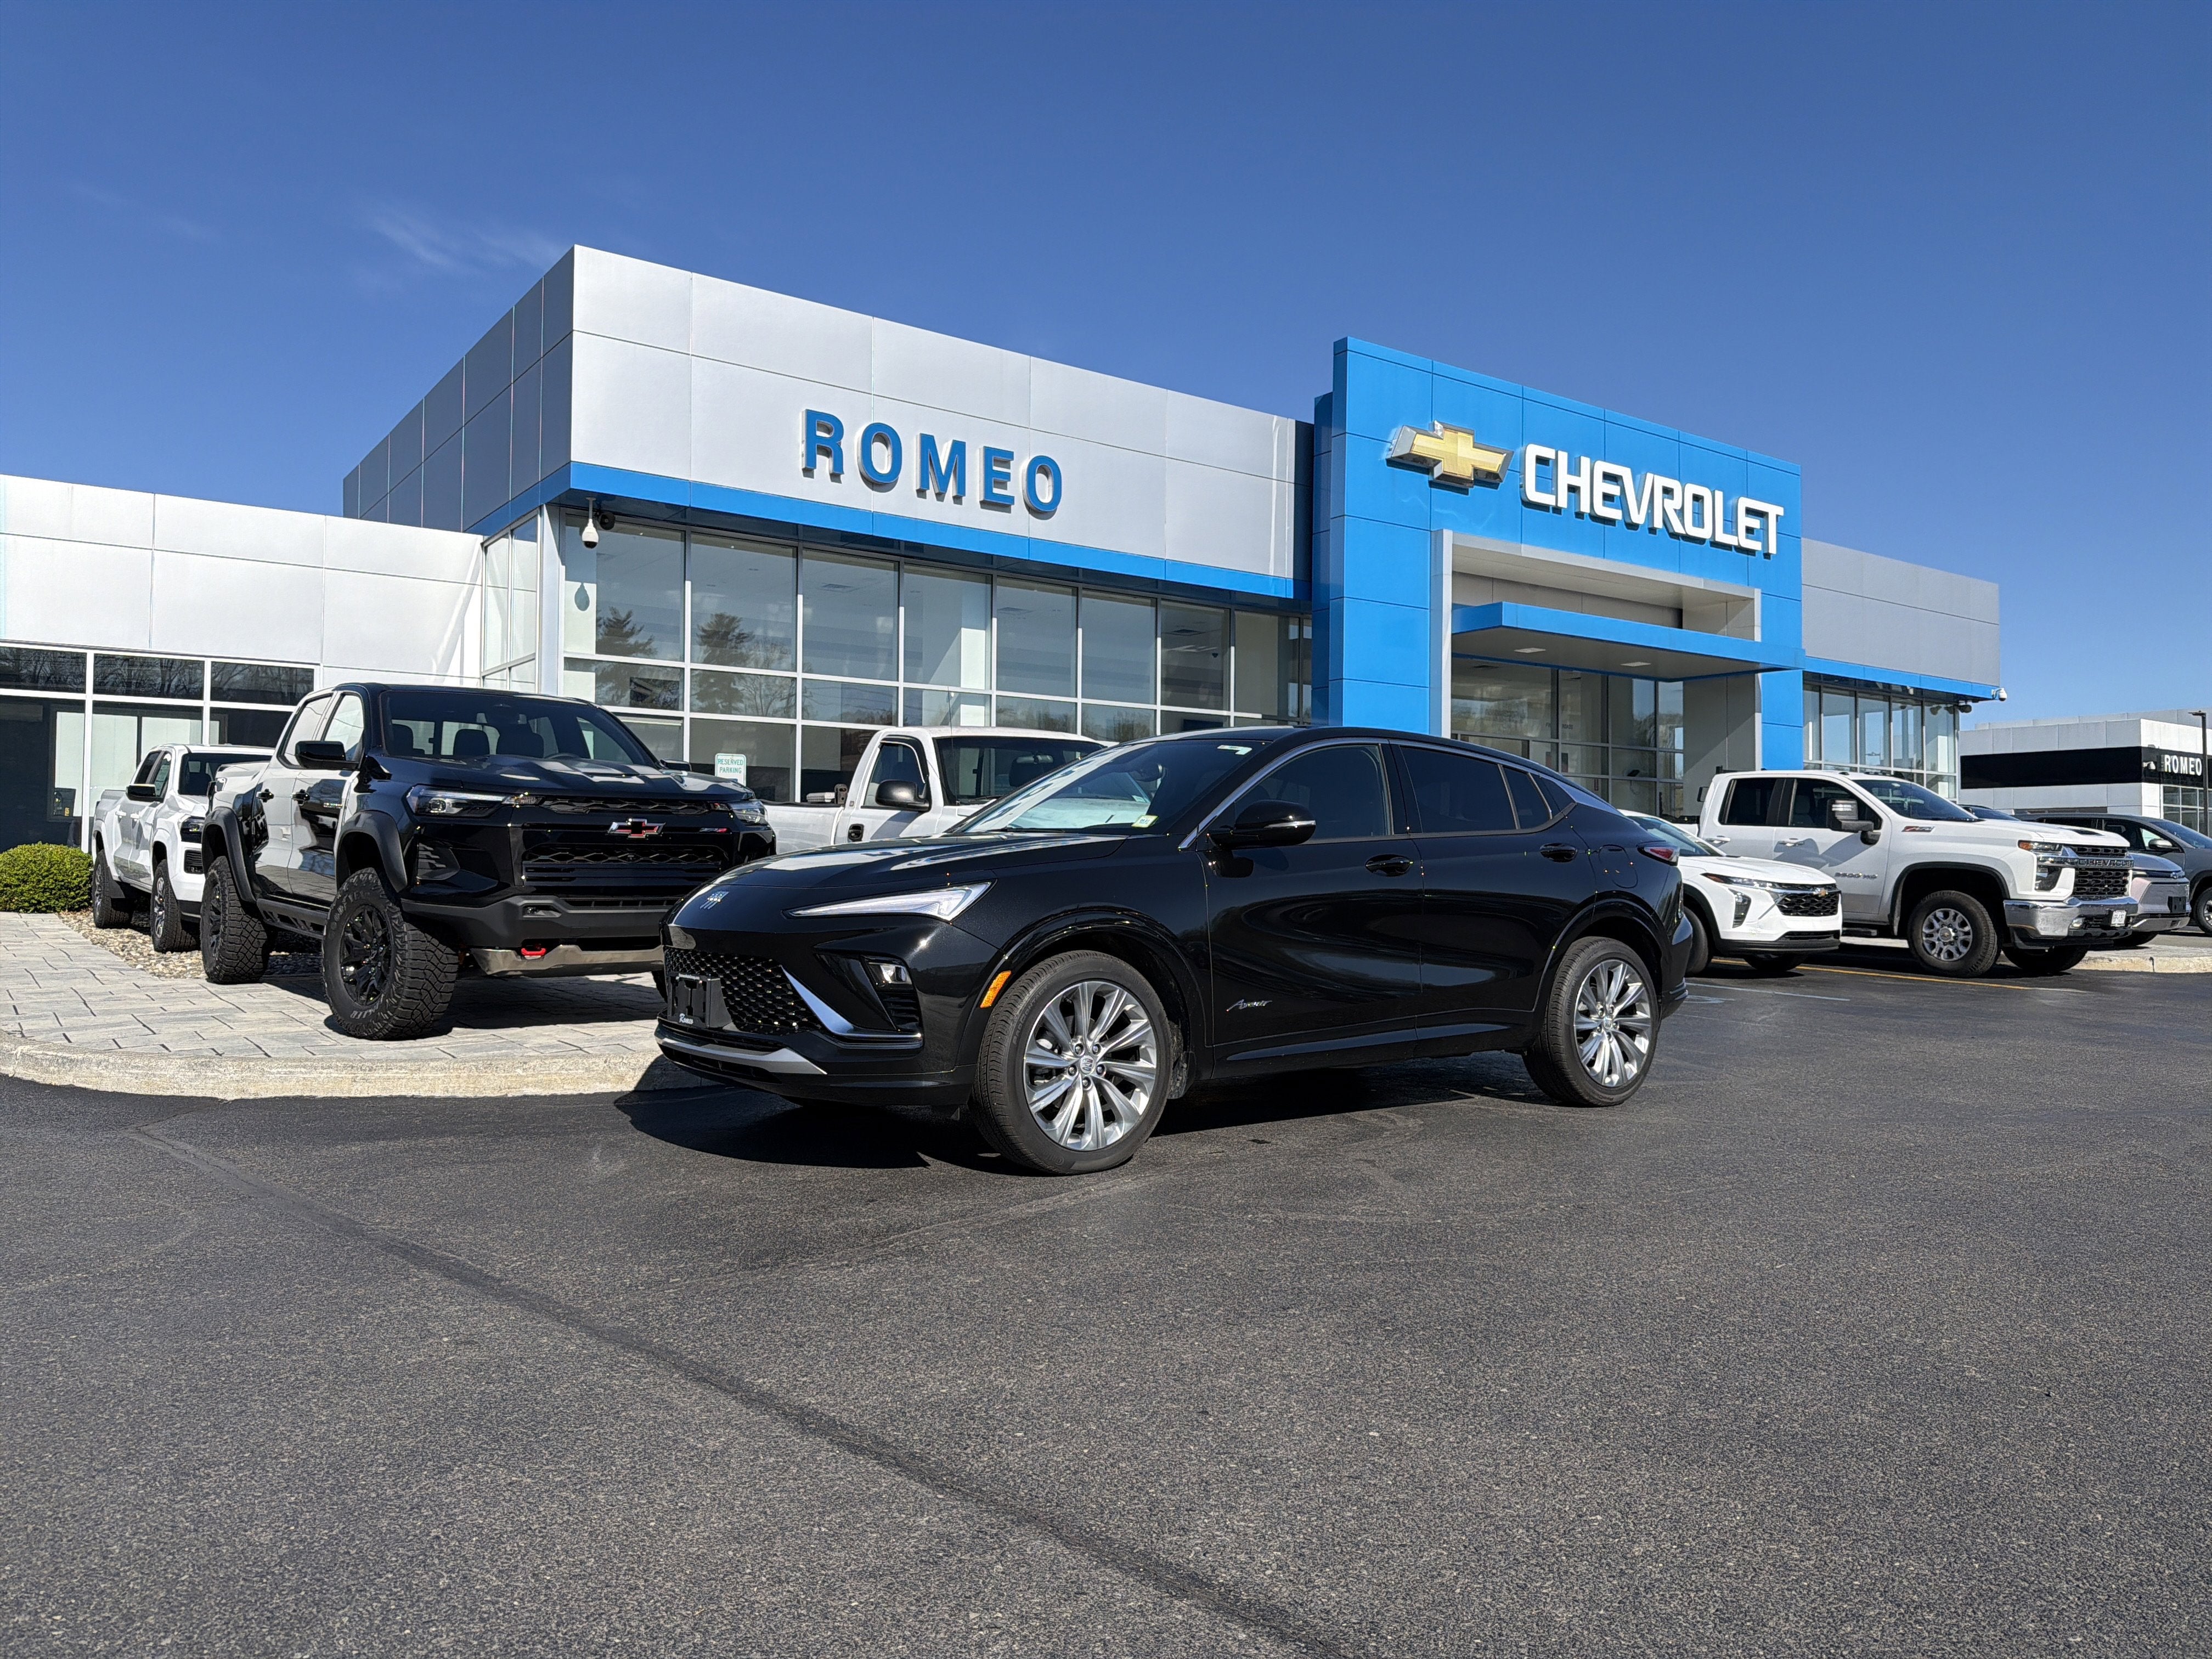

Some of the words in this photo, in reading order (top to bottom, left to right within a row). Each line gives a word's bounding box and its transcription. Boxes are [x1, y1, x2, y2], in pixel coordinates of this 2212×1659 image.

[802, 409, 1062, 512] ROMEO
[1522, 443, 1784, 555] CHEVROLET
[2164, 754, 2202, 776] ROMEO
